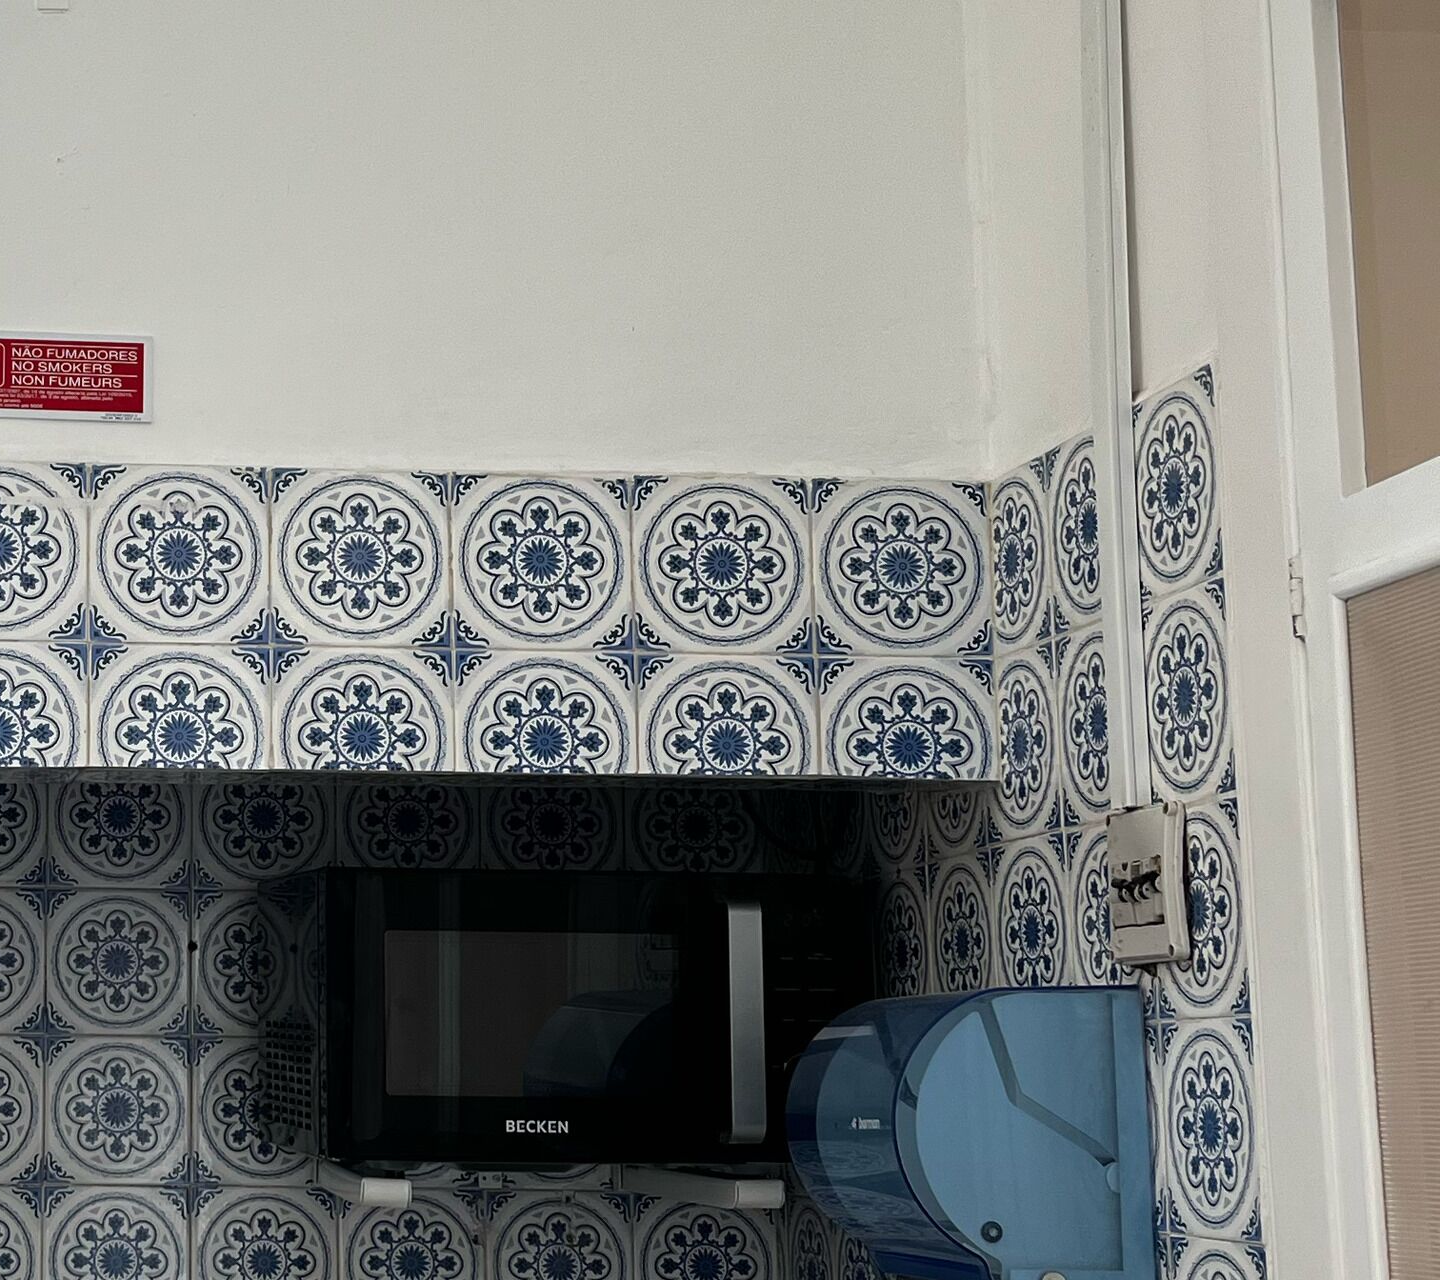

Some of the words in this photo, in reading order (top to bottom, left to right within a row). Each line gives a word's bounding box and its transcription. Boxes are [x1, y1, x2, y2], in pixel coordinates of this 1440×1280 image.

[12, 345, 42, 358] NÃO
[47, 348, 138, 361] FUMADORES
[12, 361, 34, 372] NO
[38, 362, 112, 374] SMOKERS
[12, 375, 44, 386] NON
[50, 376, 122, 388] FUMEURS
[506, 1120, 568, 1133] BECKEN
